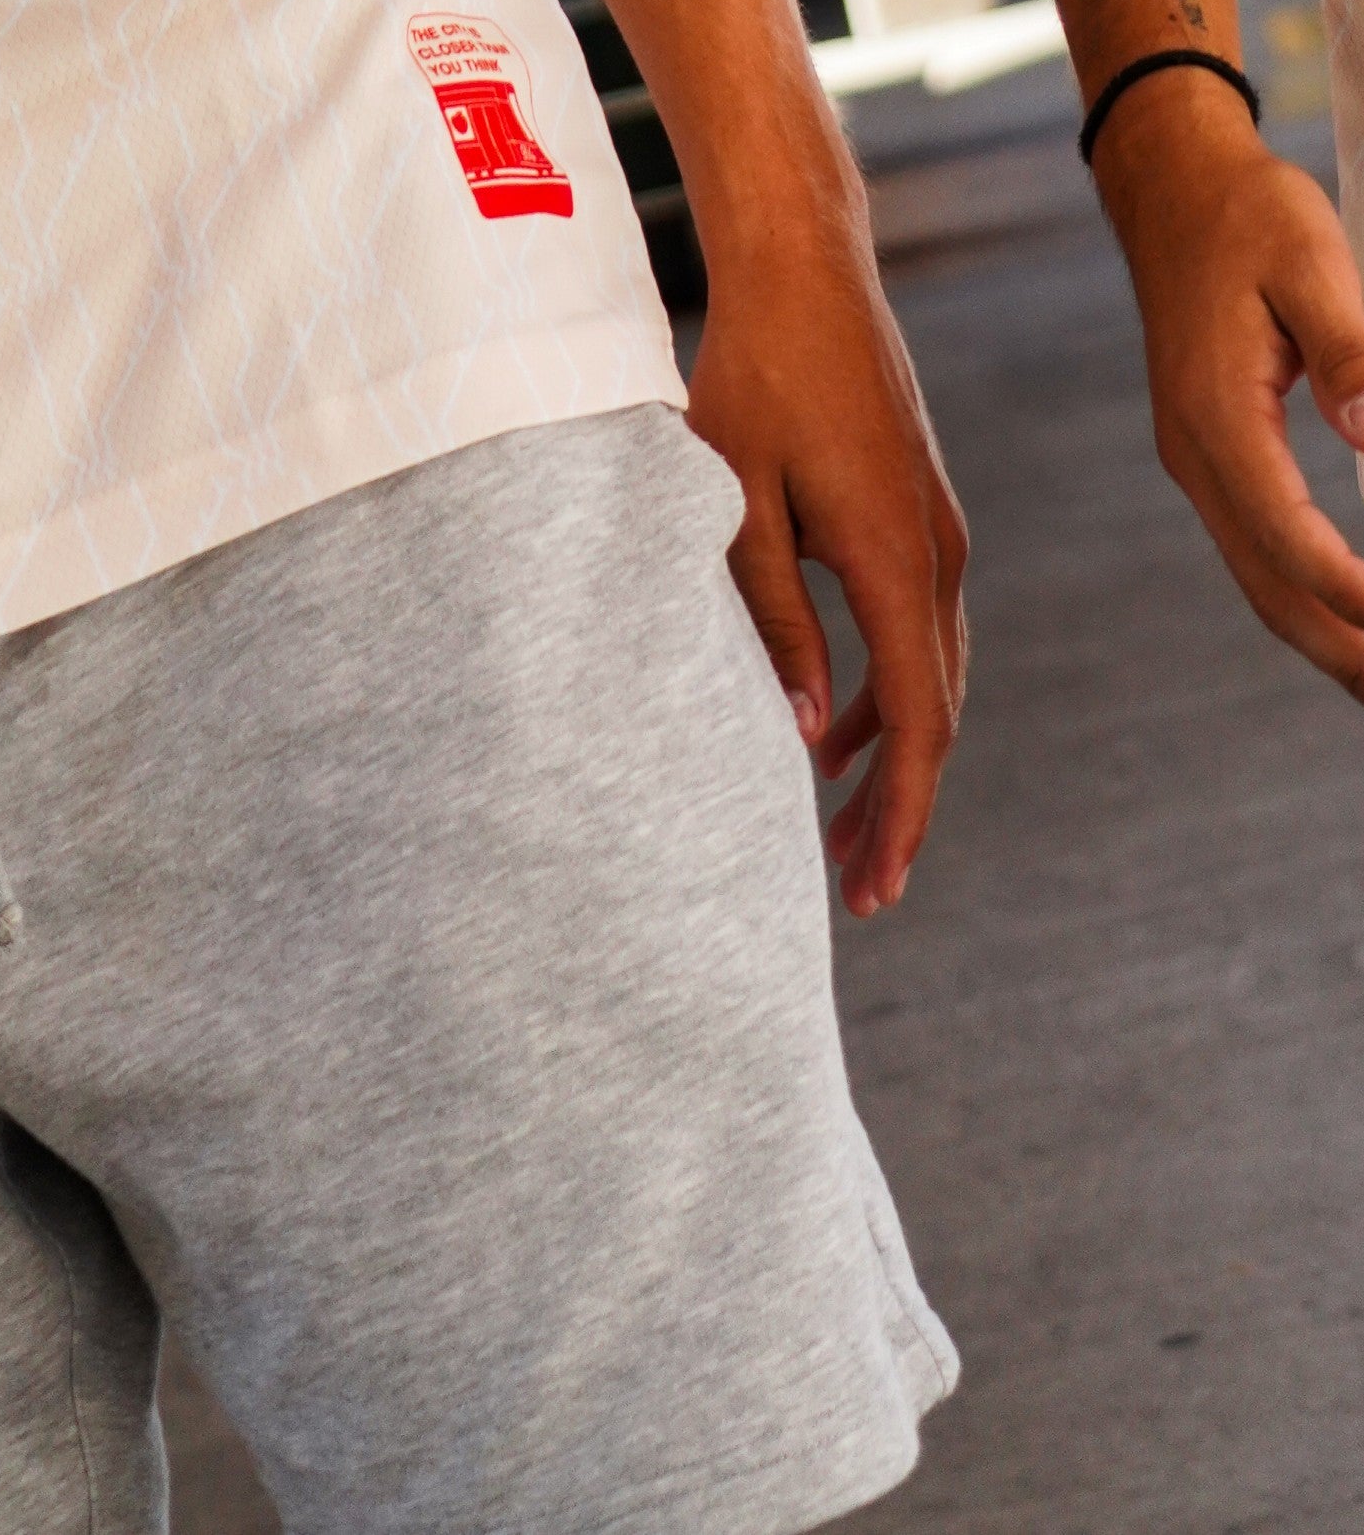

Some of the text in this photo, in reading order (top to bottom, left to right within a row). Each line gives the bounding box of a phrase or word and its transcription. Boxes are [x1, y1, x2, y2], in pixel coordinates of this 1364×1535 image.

[411, 26, 440, 43] THE
[427, 59, 502, 76] YOU THINK
